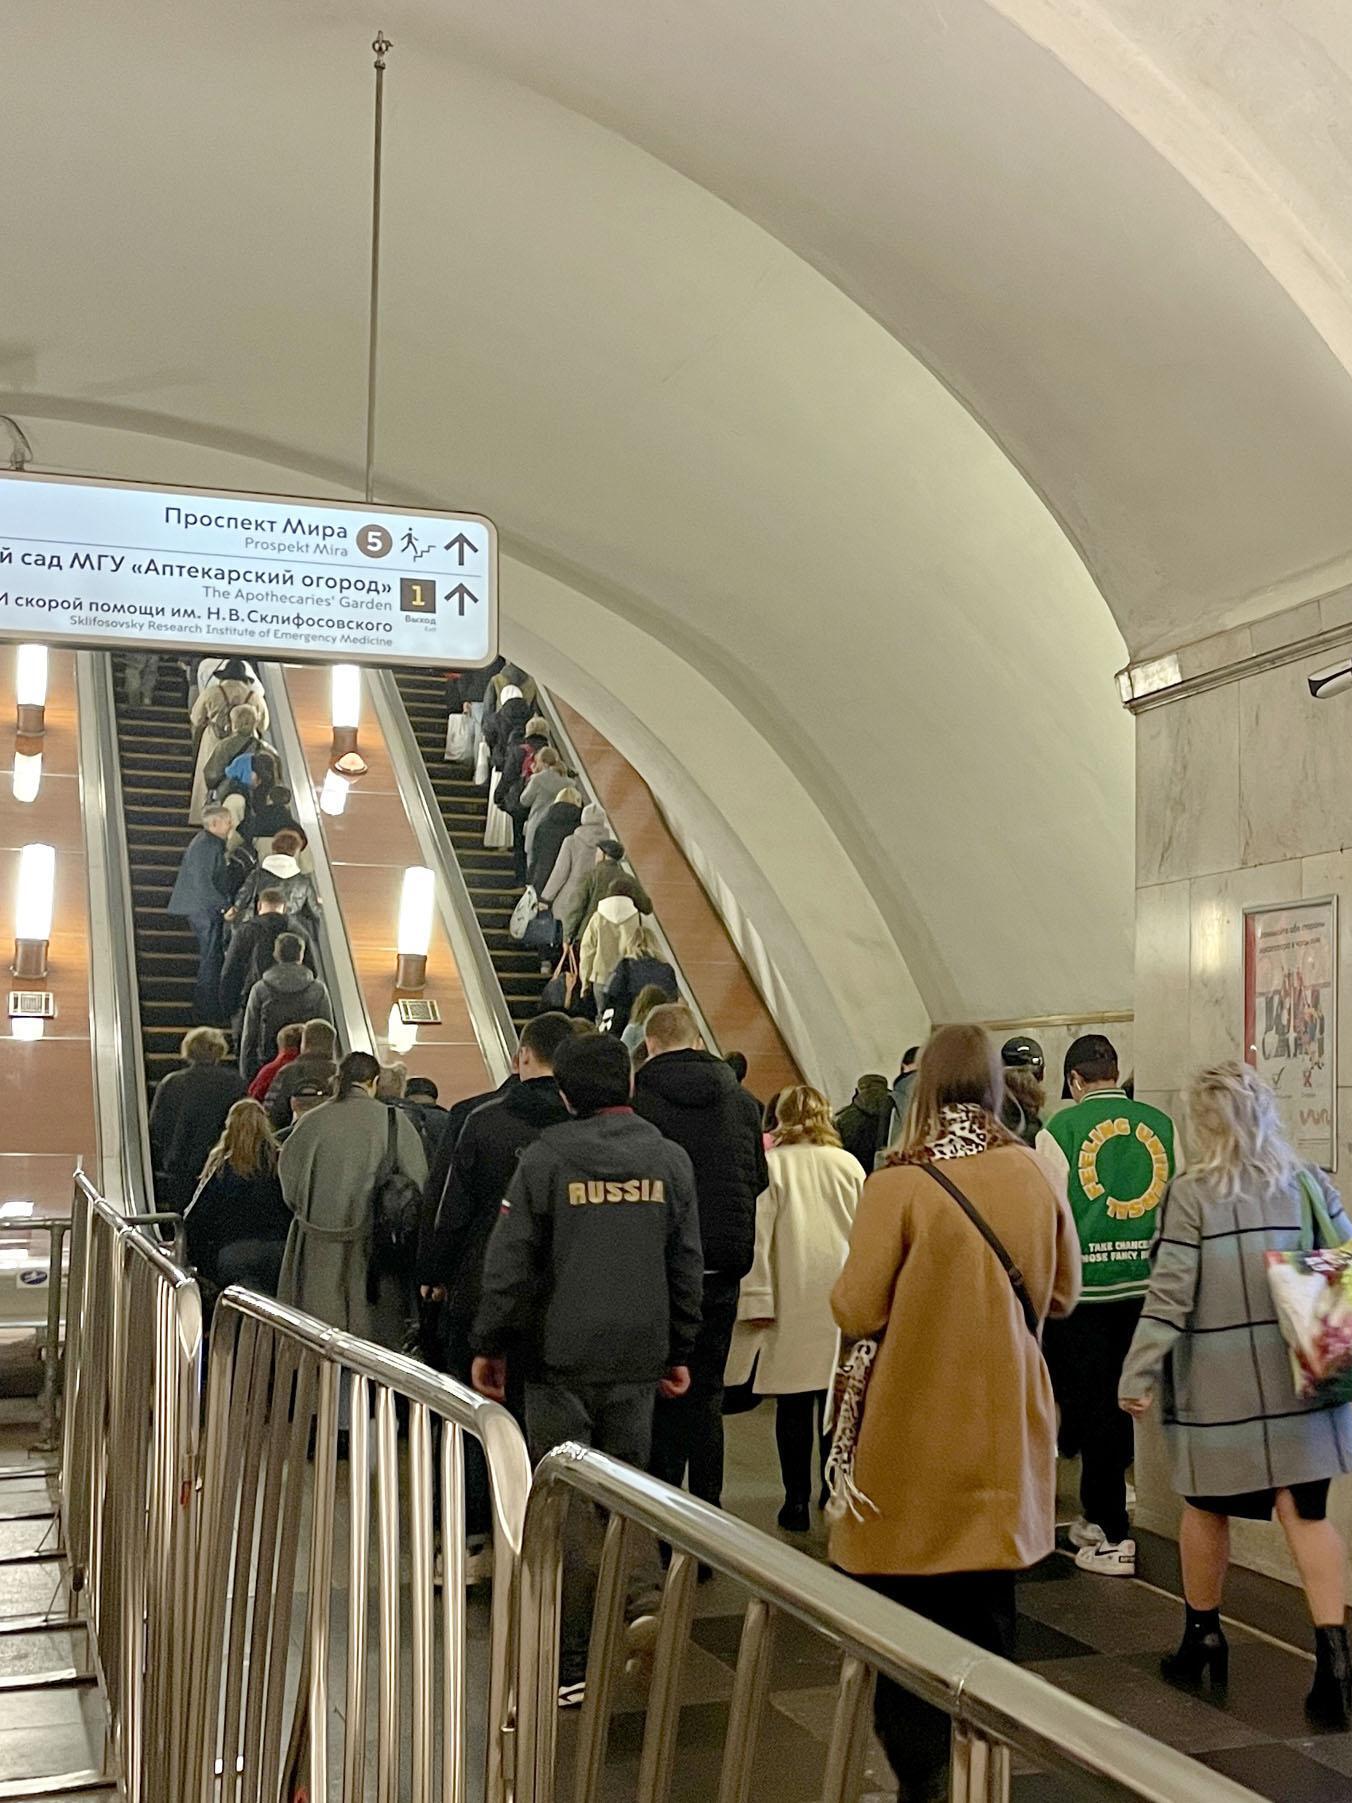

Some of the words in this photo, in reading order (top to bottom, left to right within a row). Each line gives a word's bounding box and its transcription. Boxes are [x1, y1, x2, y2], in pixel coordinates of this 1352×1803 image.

[164, 506, 277, 531] Проспект
[282, 518, 347, 539] Мира
[245, 537, 310, 553] Prospekt
[313, 543, 348, 557] Mira
[367, 531, 382, 551] 5
[21, 552, 62, 571] сад
[69, 552, 124, 572] МГУ
[132, 558, 294, 586] «Аптекарский
[302, 573, 392, 594] огород»
[15, 595, 83, 612] скорой
[89, 600, 165, 617] помощи
[171, 606, 201, 619] им.
[203, 586, 230, 599] The
[235, 587, 335, 606] Apothecaries'
[339, 597, 392, 611] Garden
[412, 585, 425, 606] 1
[70, 615, 144, 631] Sklifosovsky
[148, 620, 202, 634] Research
[206, 625, 256, 638] Institute
[259, 628, 269, 639] of
[273, 630, 336, 645] Emergency
[339, 634, 393, 647] Medicine
[405, 614, 436, 625] Выход
[1078, 1117, 1131, 1201] FEELING
[568, 1179, 666, 1206] RUSSIA
[1088, 1241, 1113, 1252] TAKE
